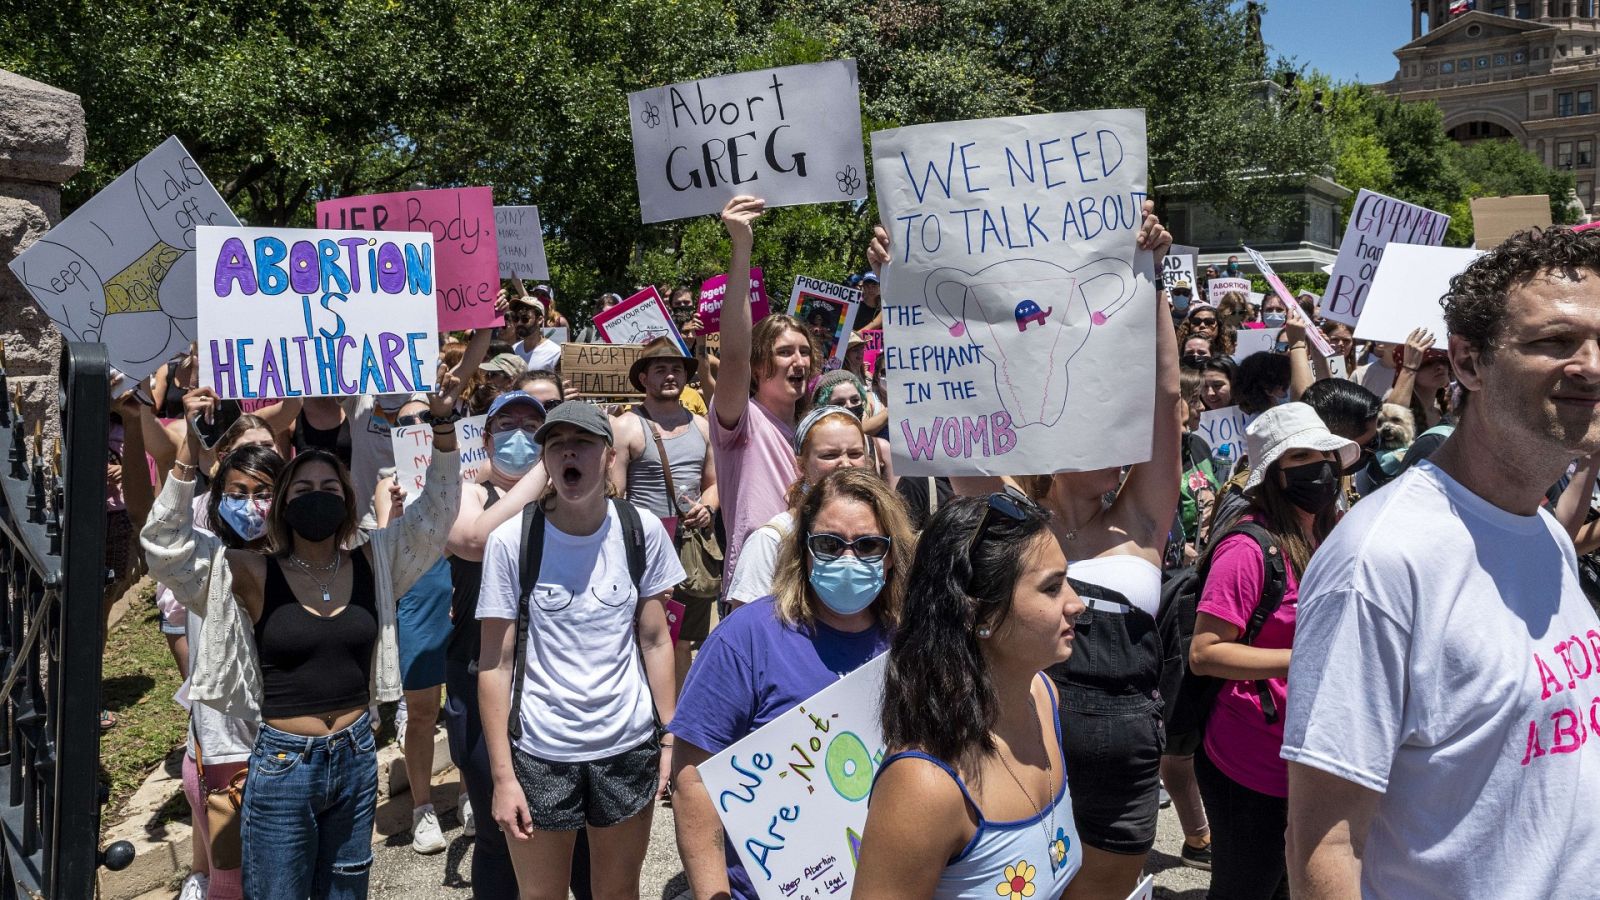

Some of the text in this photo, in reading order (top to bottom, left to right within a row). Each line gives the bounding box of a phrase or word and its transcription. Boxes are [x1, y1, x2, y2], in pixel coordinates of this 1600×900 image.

[670, 73, 784, 128] Abort
[135, 156, 204, 211] Laws
[665, 125, 808, 192] GREG
[900, 129, 1124, 204] WE NEED
[175, 196, 205, 229] off
[182, 211, 219, 250] Or
[897, 192, 1147, 263] TO TALK ABOUT
[12, 260, 90, 309] Keep
[104, 247, 180, 312] Drawers
[213, 236, 433, 298] ABORTION
[797, 276, 863, 305] PROCHOICE!
[301, 291, 349, 340] IS
[604, 299, 657, 331] MIND YOUR OWN
[883, 304, 926, 326] THE
[209, 331, 432, 399] HEALTHCARE
[886, 344, 984, 374] ELEPHANT
[903, 381, 977, 404] IN THE
[900, 410, 1017, 461] WOMB
[789, 713, 830, 782] Not
[719, 751, 774, 813] We
[744, 804, 800, 881] Are
[778, 854, 837, 897] Keep Abortion
[824, 871, 844, 893] Legal
